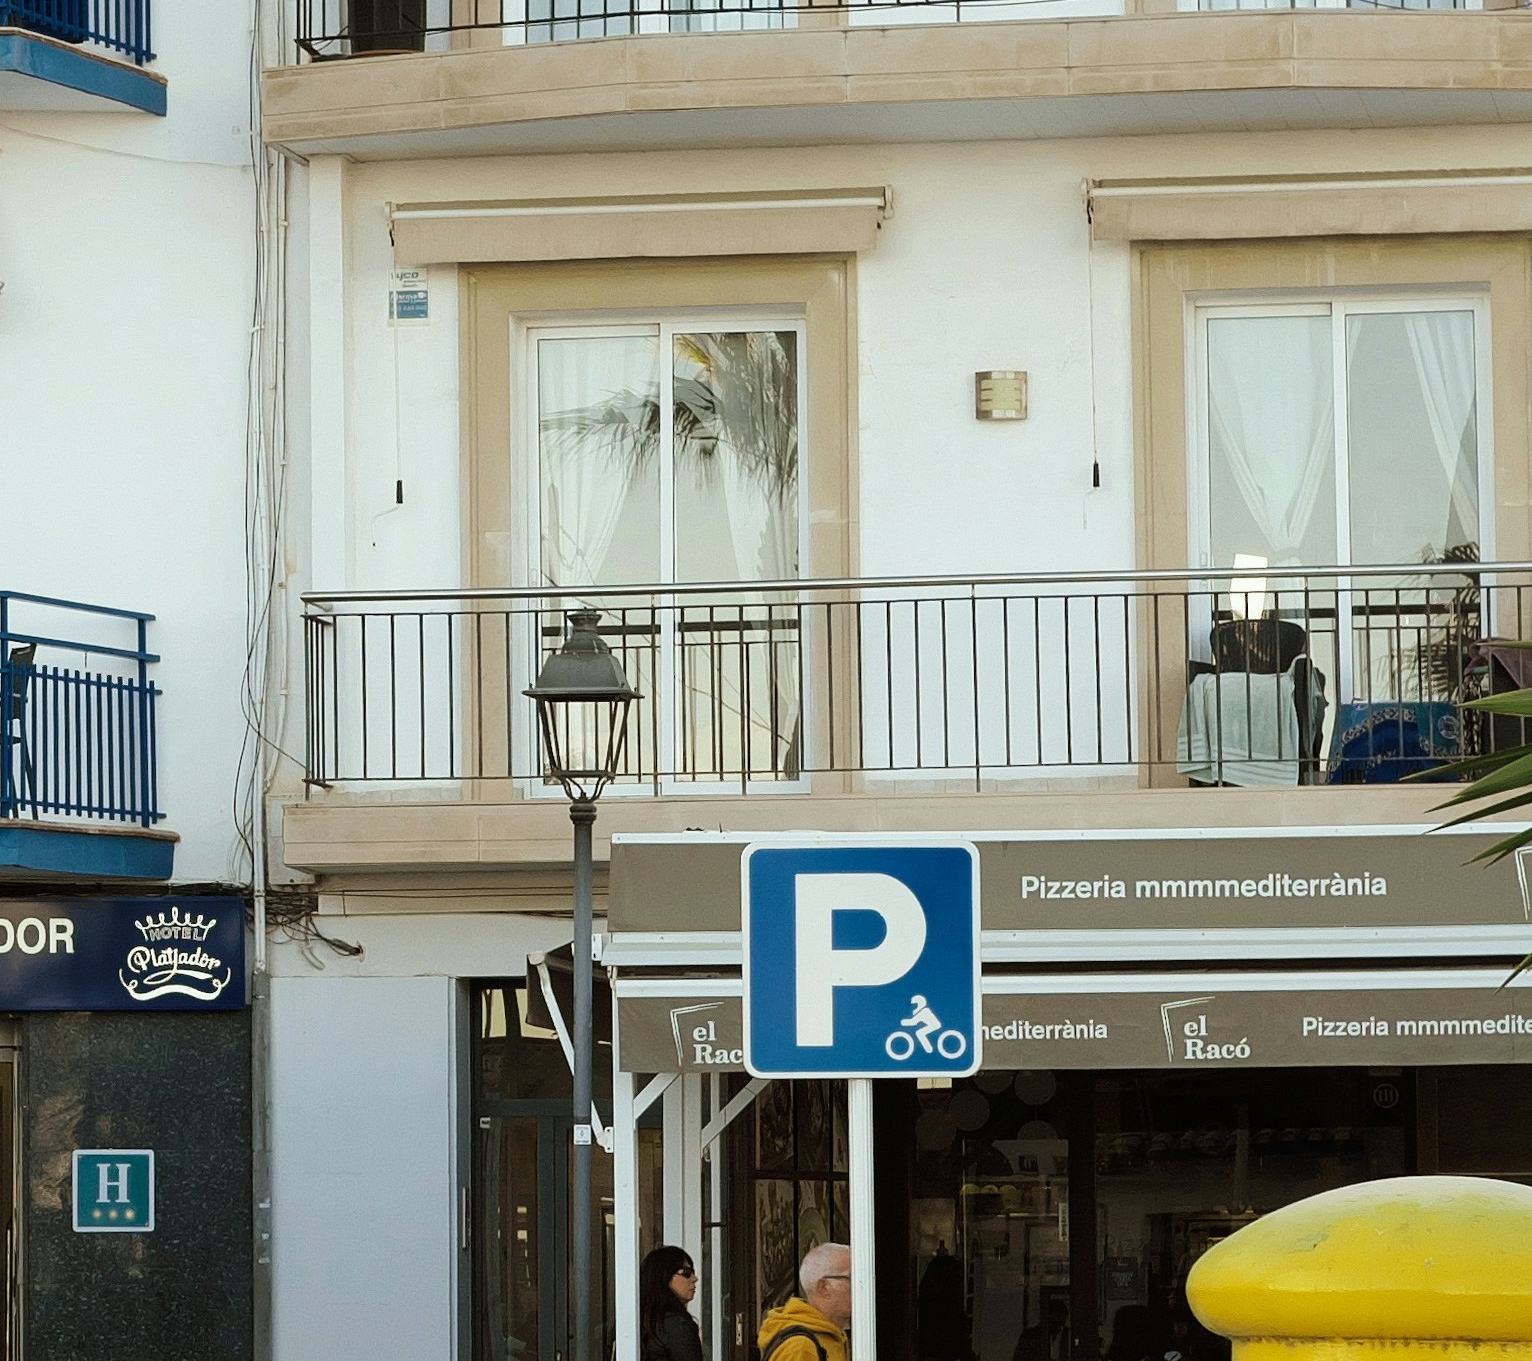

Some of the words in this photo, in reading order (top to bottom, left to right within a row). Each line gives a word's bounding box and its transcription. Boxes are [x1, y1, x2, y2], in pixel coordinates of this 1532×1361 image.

[1021, 876, 1126, 899] Pizzeria
[1135, 871, 1388, 898] mmmmediterrània
[149, 926, 204, 942] HOTEL
[127, 946, 221, 979] Platjador
[794, 872, 927, 1048] P
[692, 1020, 717, 1042] el
[1183, 1015, 1209, 1037] el
[1302, 1015, 1390, 1037] Pizzeria
[692, 1043, 744, 1065] Rac
[1183, 1038, 1251, 1060] Racó
[96, 1163, 132, 1203] H
